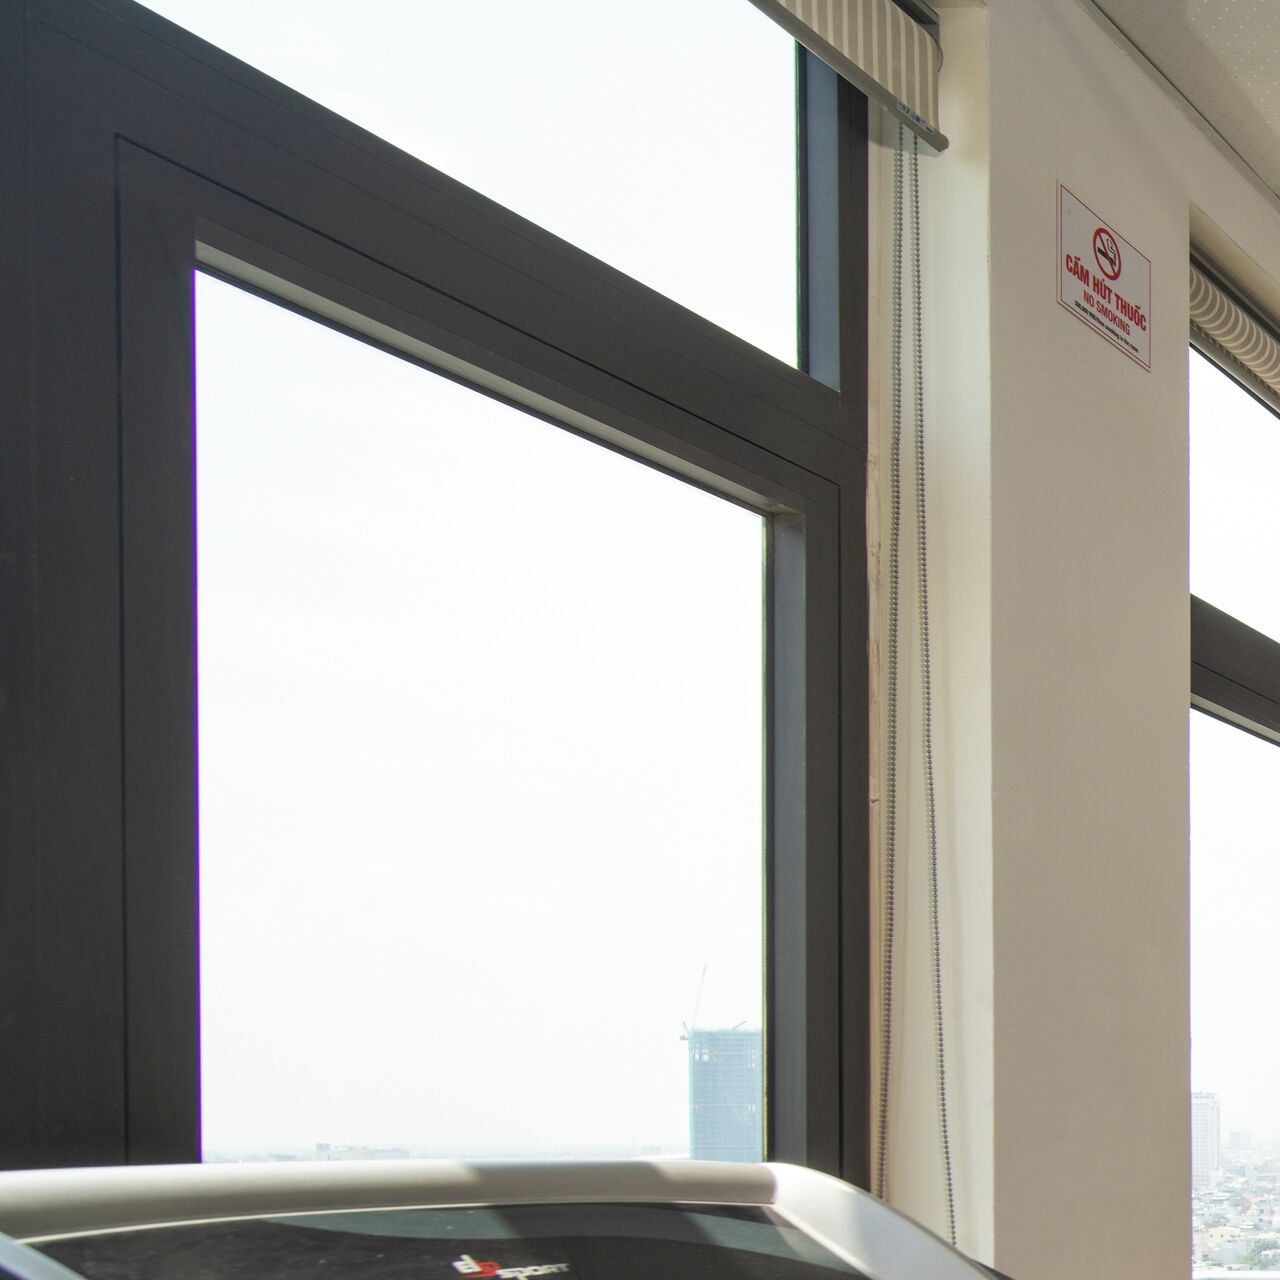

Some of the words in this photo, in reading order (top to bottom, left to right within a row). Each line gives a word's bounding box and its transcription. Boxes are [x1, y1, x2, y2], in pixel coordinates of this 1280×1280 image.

[1066, 254, 1089, 287] CẤM
[1093, 275, 1112, 304] HÚT
[1114, 292, 1146, 332] THUỐC
[1083, 290, 1095, 307] NO
[1096, 300, 1131, 336] SMOKING
